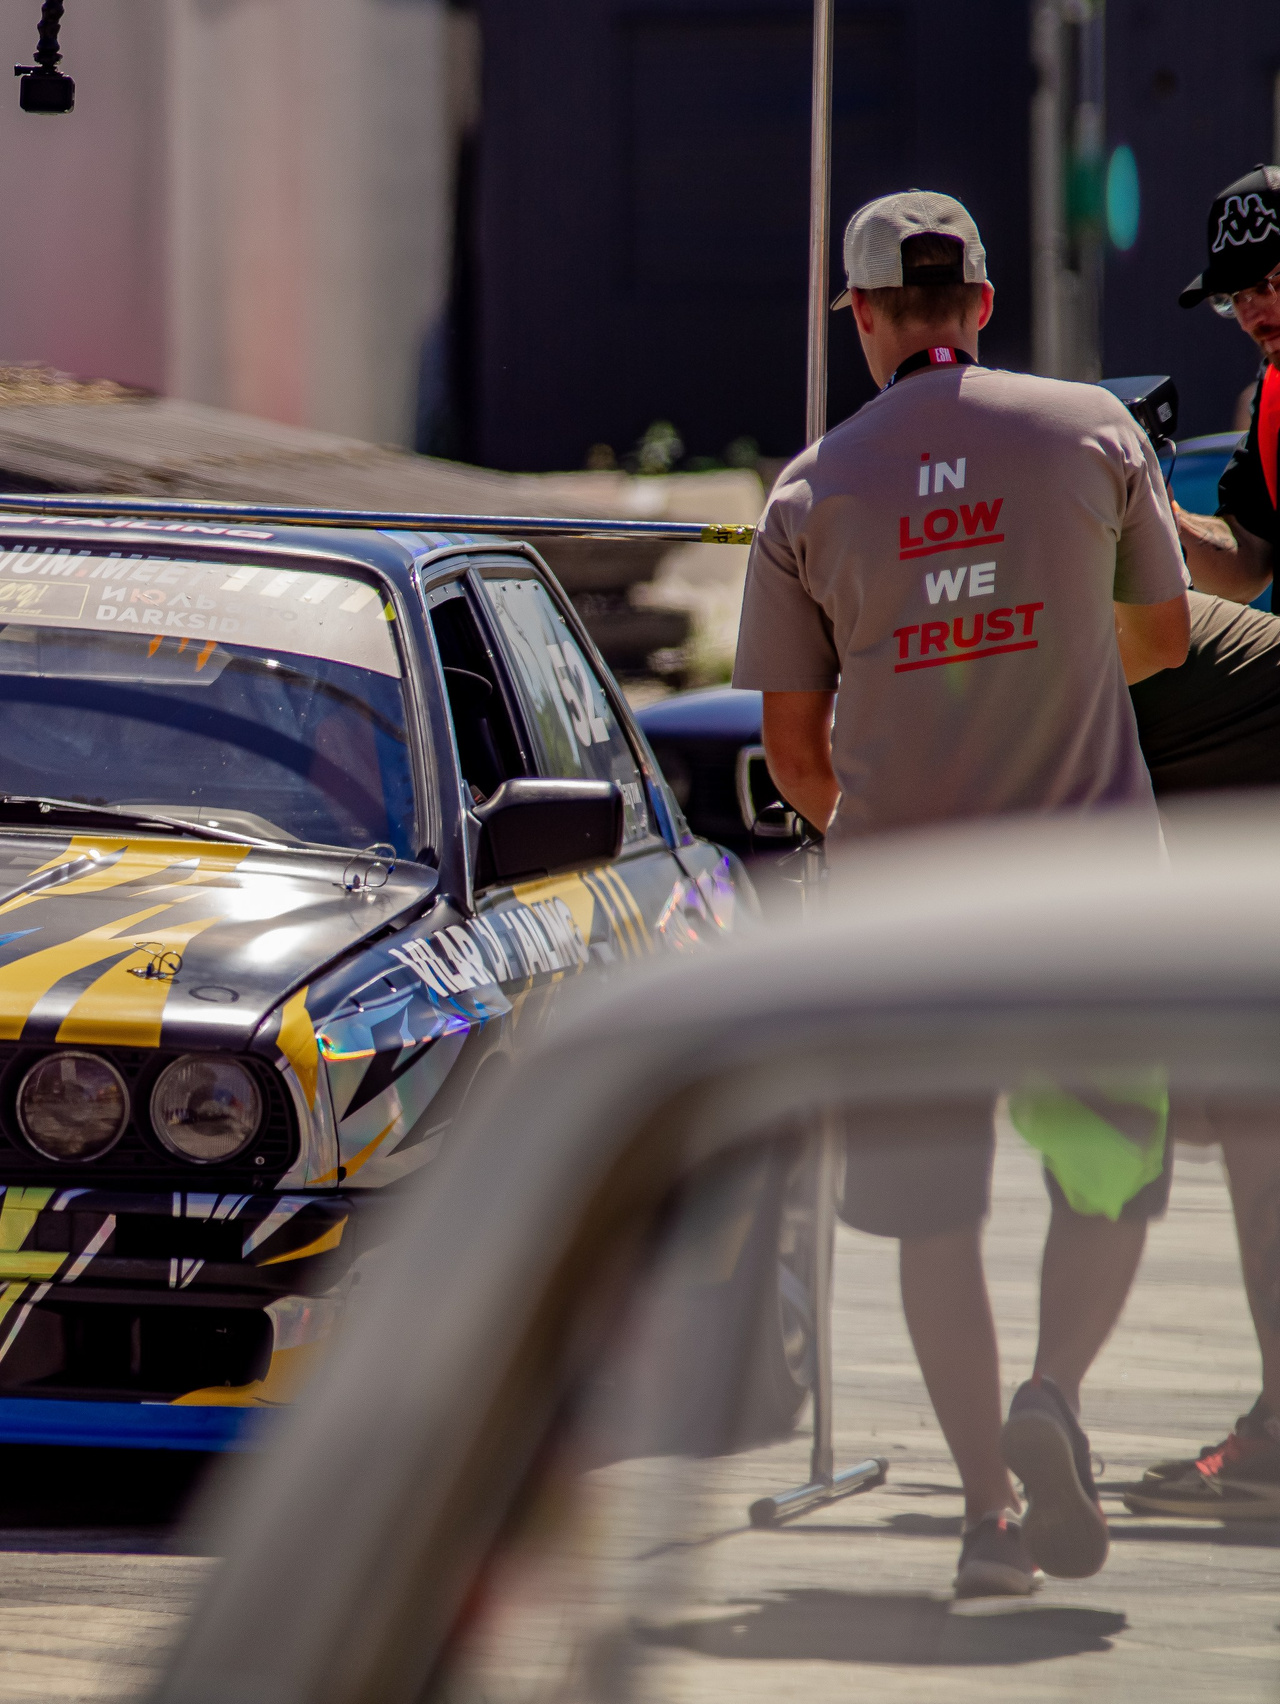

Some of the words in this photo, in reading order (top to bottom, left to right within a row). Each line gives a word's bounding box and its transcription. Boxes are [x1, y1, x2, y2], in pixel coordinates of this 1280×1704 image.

[899, 498, 1005, 550] LOW
[925, 561, 997, 605] WE
[893, 602, 1045, 660] TRUST
[547, 641, 610, 747] 52
[388, 925, 496, 998] VILAR
